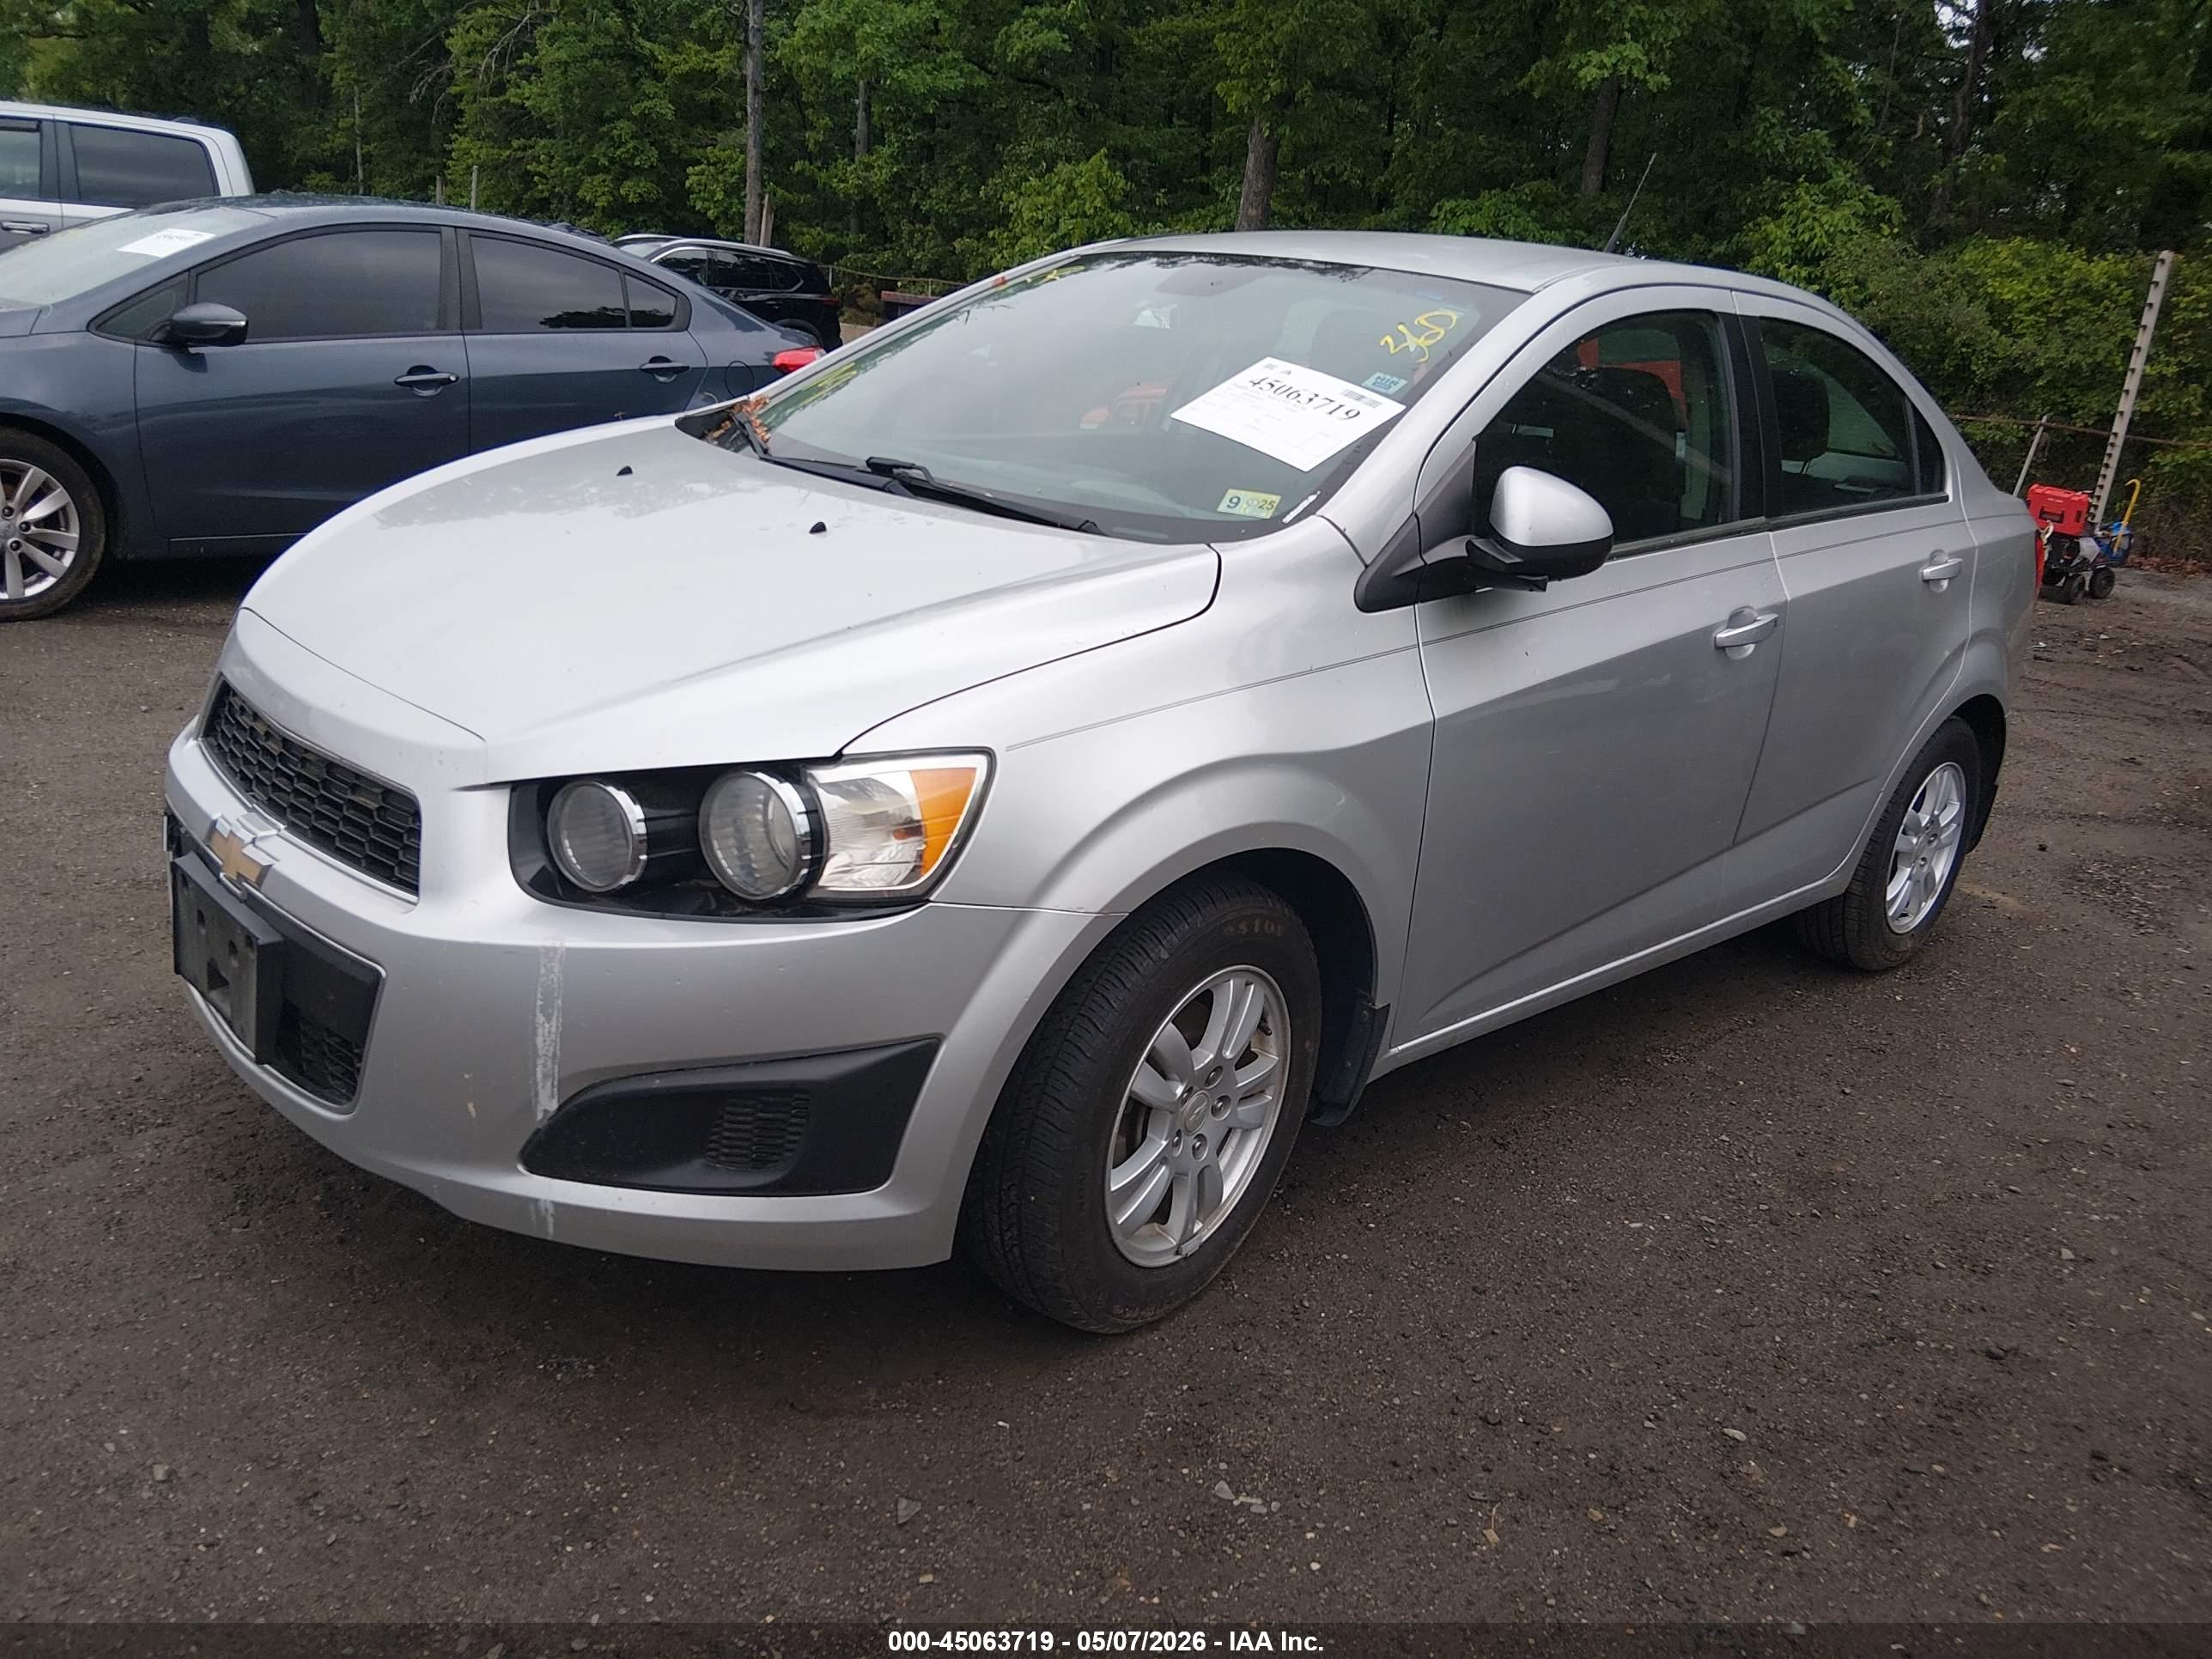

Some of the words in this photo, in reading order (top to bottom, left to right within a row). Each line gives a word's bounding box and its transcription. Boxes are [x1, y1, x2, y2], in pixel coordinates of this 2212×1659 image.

[1249, 376, 1361, 421] 45063719
[1226, 495, 1242, 509] 9
[1258, 500, 1277, 511] 25
